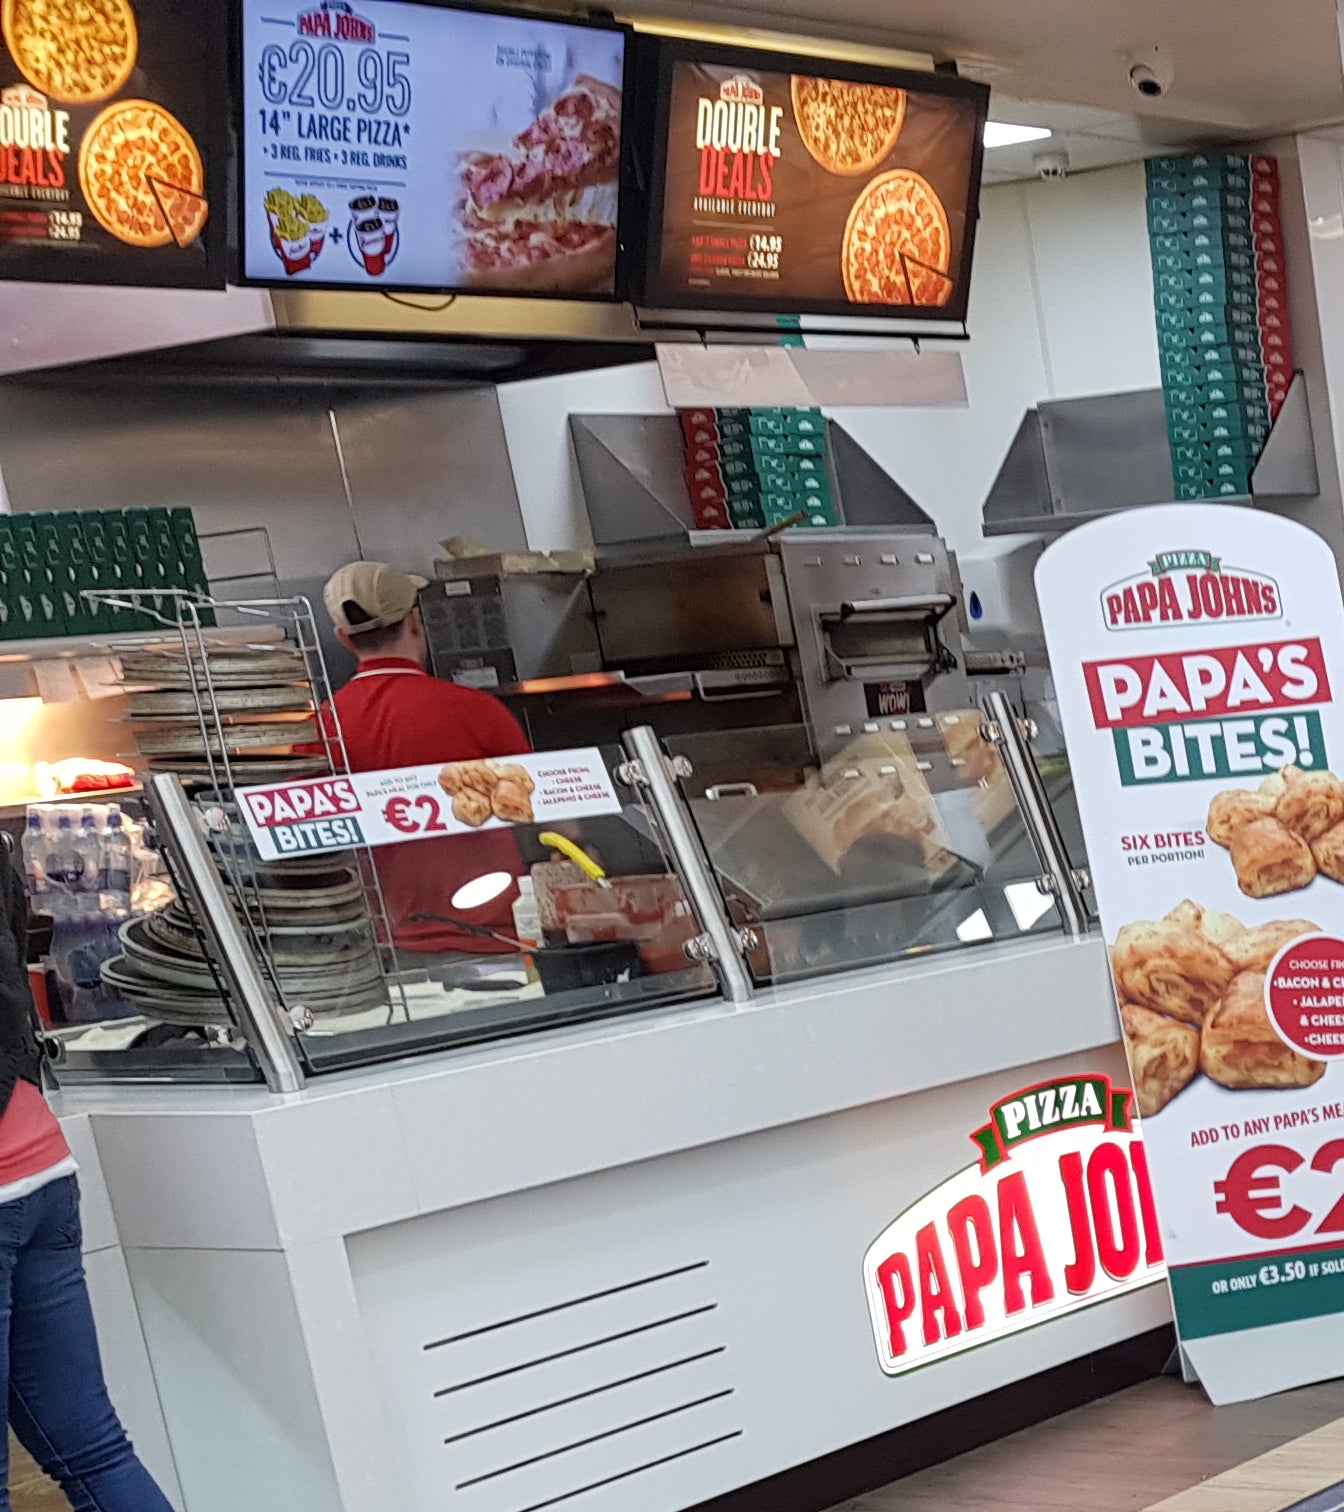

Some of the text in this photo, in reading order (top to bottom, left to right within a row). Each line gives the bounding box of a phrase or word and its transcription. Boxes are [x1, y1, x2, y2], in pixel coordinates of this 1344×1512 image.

[300, 13, 331, 38] PAPA
[258, 39, 411, 117] €20.95
[0, 104, 70, 153] OUBLE
[259, 109, 290, 136] 14"
[298, 112, 351, 143] LARGE
[696, 97, 783, 158] DOUBLE
[304, 146, 331, 164] FRIES
[373, 152, 407, 170] DRINKS
[698, 142, 774, 200] DEALS
[1161, 552, 1208, 569] PIZZA
[1106, 576, 1183, 625] PAPA
[1097, 644, 1318, 721] PAPA'S
[1126, 716, 1314, 780] BITES!
[247, 780, 358, 825] PAPA'S
[382, 794, 447, 833] €2
[275, 818, 360, 851] BITES!
[1121, 830, 1206, 851] SIX BITES
[1127, 855, 1149, 867] PER
[1277, 976, 1319, 989] BACON
[1321, 976, 1331, 989] &
[1289, 959, 1329, 970] CHOOSE
[1299, 1014, 1309, 1027] &
[1000, 1082, 1103, 1139] PIZZA
[1191, 1128, 1219, 1147] ADD
[1221, 1123, 1240, 1141] TO
[1244, 1117, 1270, 1137] ANY
[1273, 1107, 1320, 1131] PAPA'S
[876, 1170, 1055, 1359] PAPA
[1212, 1280, 1229, 1295] OR
[1230, 1274, 1258, 1292] ONLY
[1259, 1260, 1306, 1286] €3.50
[1308, 1264, 1320, 1277] IF
